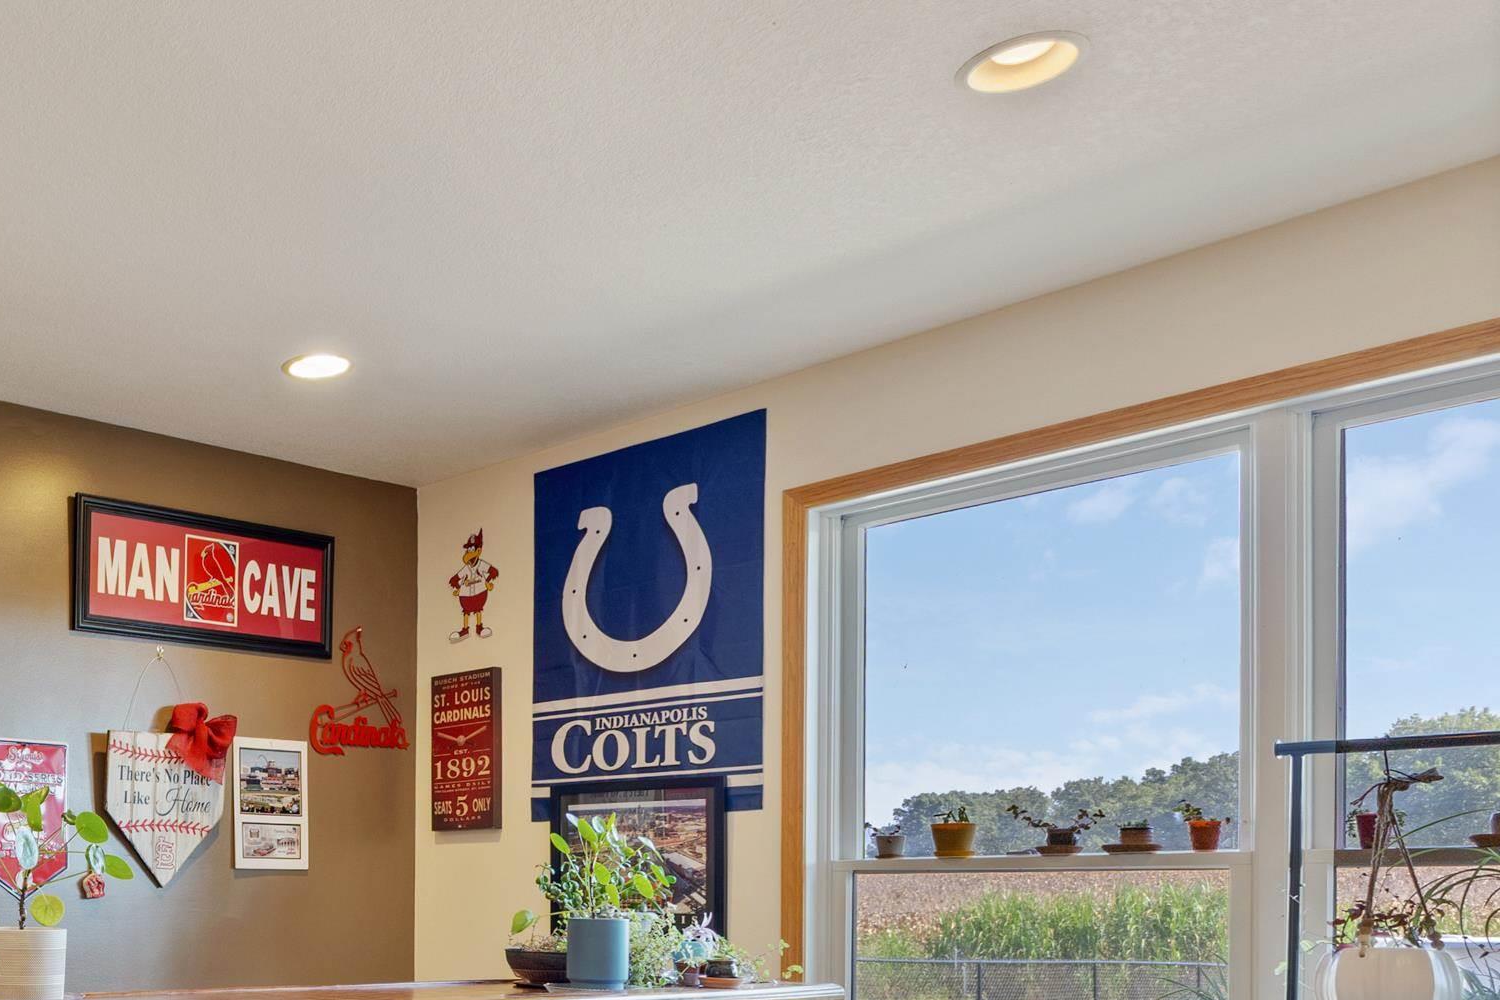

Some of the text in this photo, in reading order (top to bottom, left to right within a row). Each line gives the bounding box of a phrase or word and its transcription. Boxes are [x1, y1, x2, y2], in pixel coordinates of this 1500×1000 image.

[97, 536, 316, 622] MAN CAVE
[434, 671, 491, 686] BUSCH STADIUM
[434, 686, 491, 708] ST. LOUIS
[433, 704, 491, 724] CARDINALS
[595, 706, 708, 731] INDIANAPOLIS
[309, 704, 410, 755] Cardinals
[551, 720, 716, 774] COLTS
[28, 772, 63, 784] SERIES
[118, 764, 211, 787] There's No Place
[434, 755, 491, 780] 1892
[124, 786, 211, 816] Like Home
[434, 794, 491, 817] SEATS 5 ONLY
